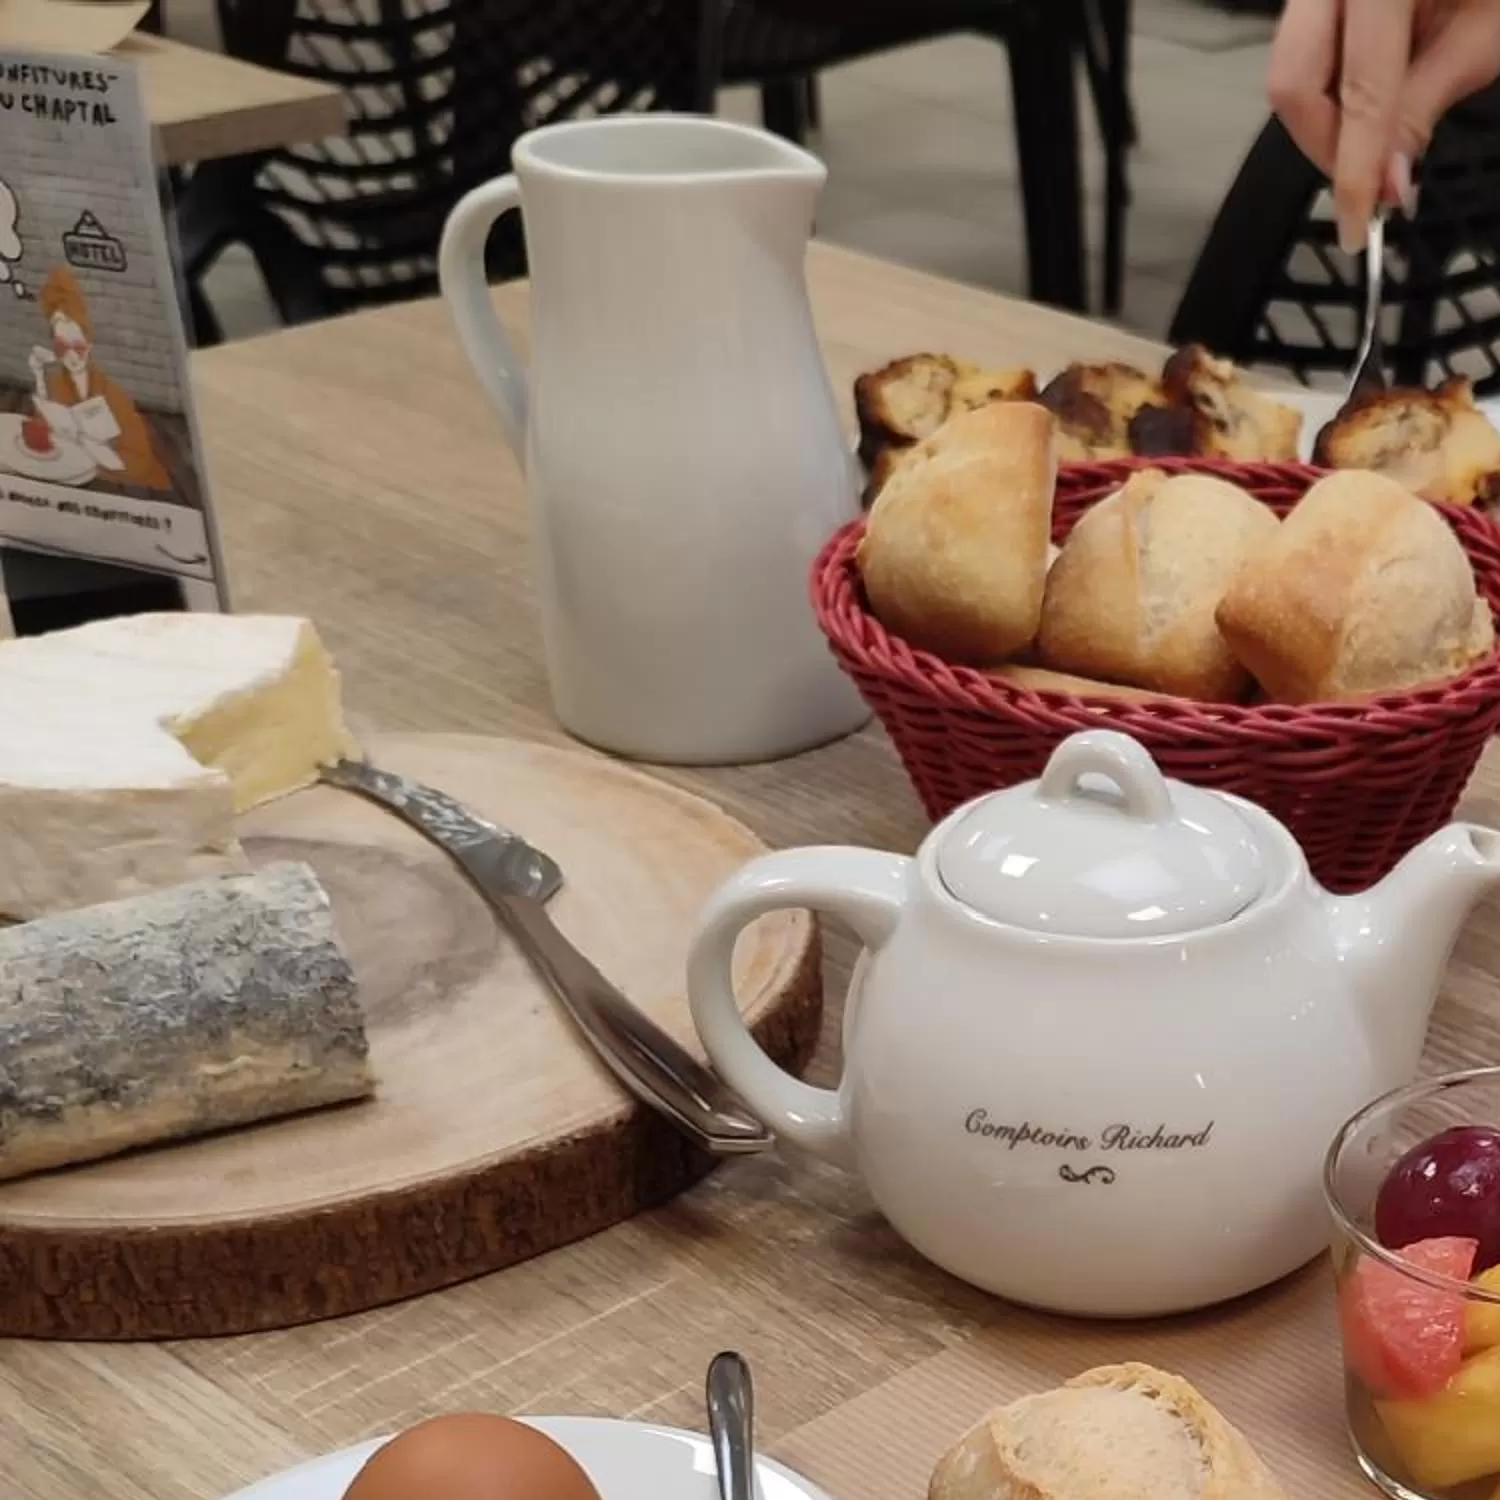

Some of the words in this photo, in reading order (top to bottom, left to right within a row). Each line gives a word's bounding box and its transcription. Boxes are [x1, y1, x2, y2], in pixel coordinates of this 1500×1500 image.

[22, 94, 116, 126] CHAPTAL
[964, 1108, 1089, 1150] Comptoirs
[1101, 1120, 1215, 1151] Richard
